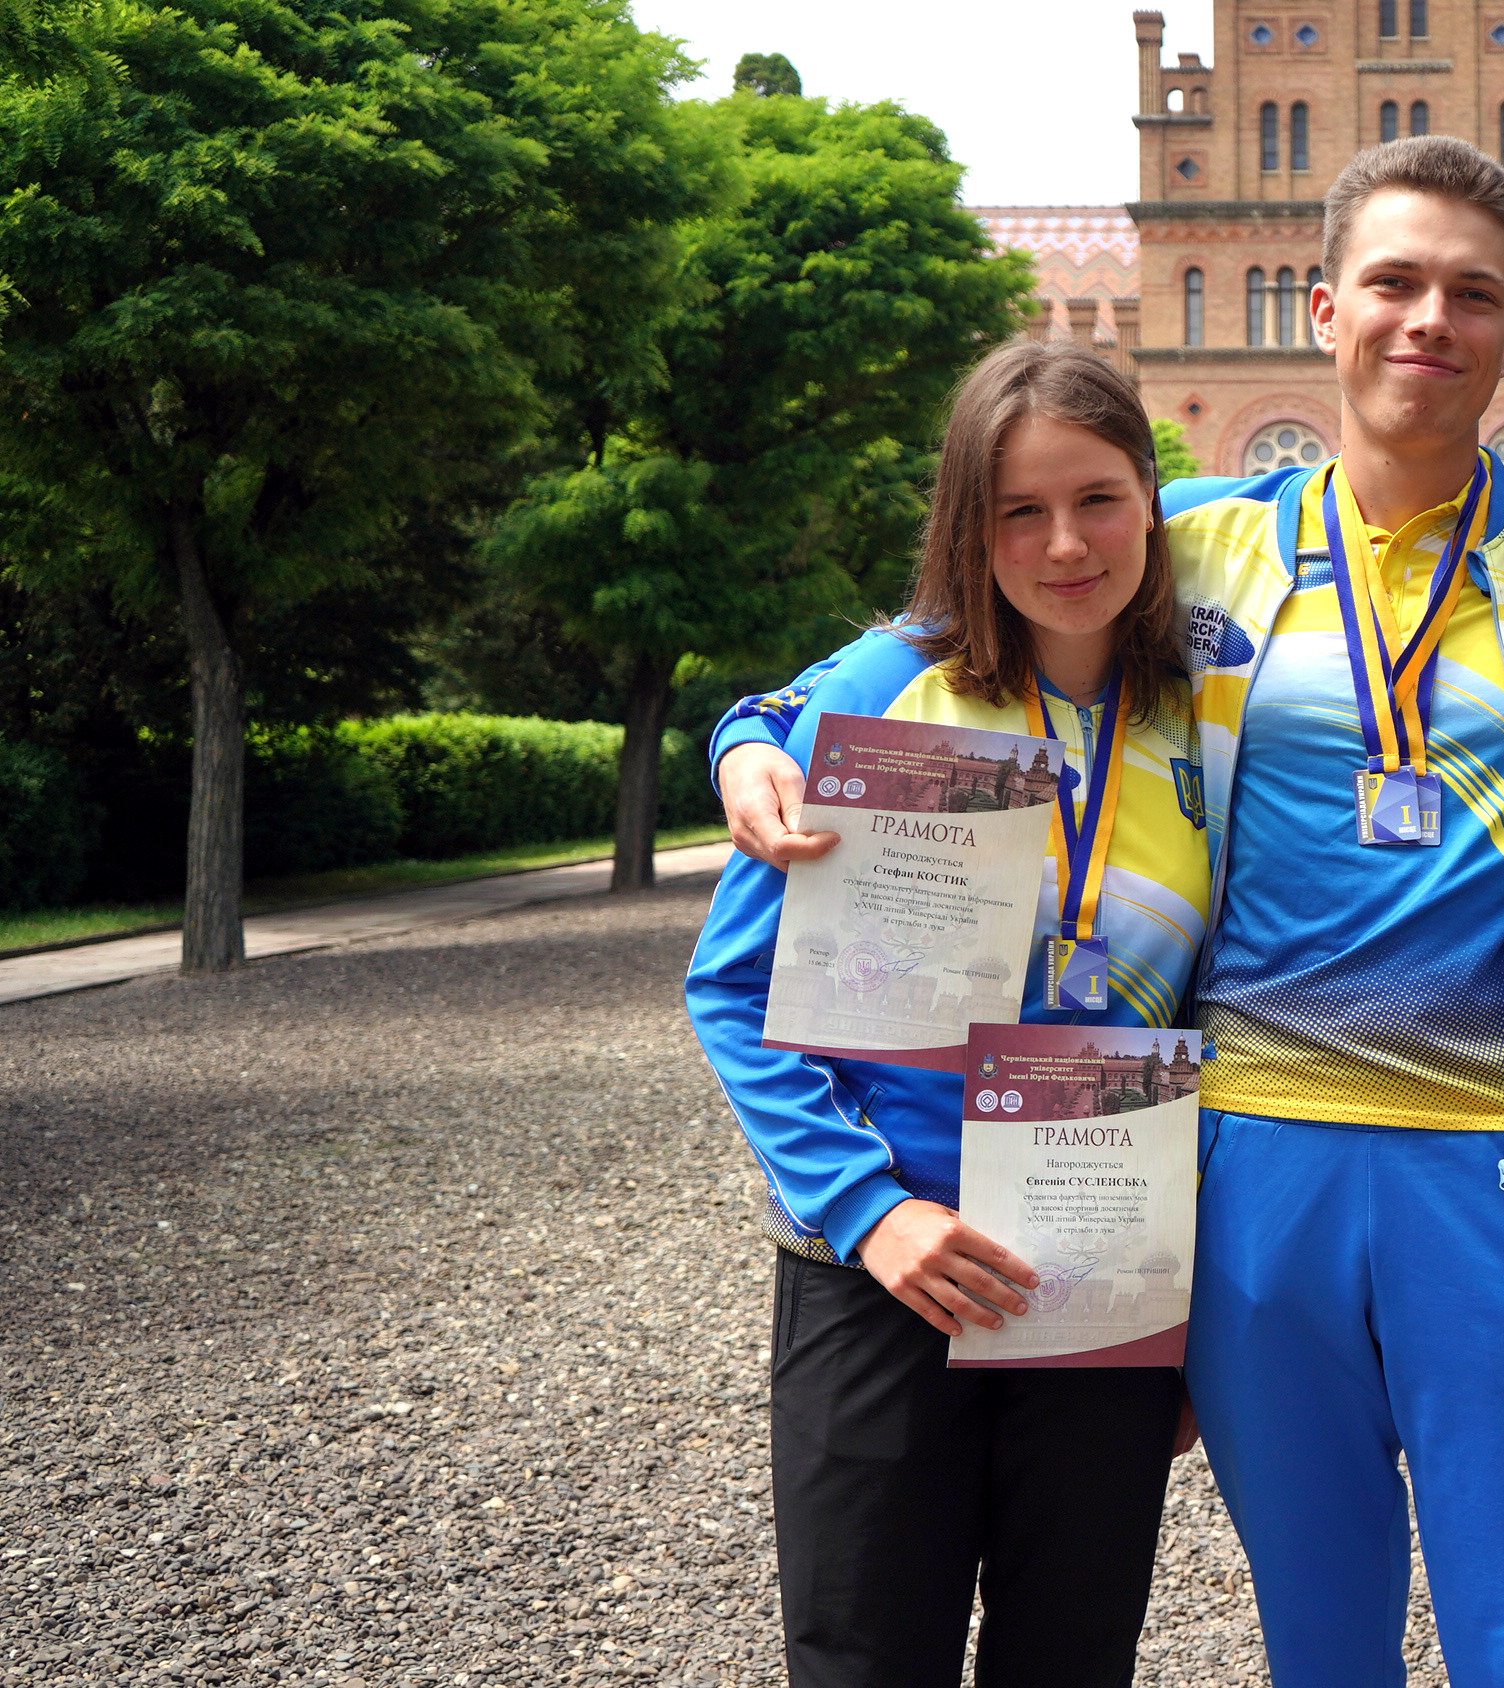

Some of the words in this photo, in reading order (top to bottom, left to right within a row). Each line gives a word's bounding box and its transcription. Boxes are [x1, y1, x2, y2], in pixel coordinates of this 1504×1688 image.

[849, 744, 903, 756] Чернівецький
[905, 751, 958, 762] національний
[878, 757, 924, 767] університет
[855, 762, 875, 770] імені
[877, 764, 896, 773] Юрія
[899, 767, 946, 778] Федьковича
[870, 814, 977, 848] ГРАМОТА
[882, 848, 964, 868] Нагороджується
[874, 864, 914, 878] Стефан
[917, 870, 968, 886] КОСТИК
[842, 878, 871, 886] студент
[873, 881, 913, 894] факультету
[914, 888, 956, 900] математики
[968, 894, 1014, 908] інформатики
[870, 893, 894, 902] високі
[896, 897, 930, 908] спортивні
[932, 902, 974, 913] досягнення
[861, 902, 882, 912] XVIII
[884, 905, 906, 915] літній
[908, 908, 948, 921] Універсіаді
[950, 914, 978, 926] України
[890, 918, 922, 928] стрільби
[929, 924, 945, 932] лука
[809, 948, 830, 958] Ректор
[942, 966, 961, 975] Роман
[1000, 1054, 1052, 1064] Чернівецький
[1030, 1065, 1074, 1073] університет
[1030, 1074, 1050, 1082] Юрія
[1034, 1127, 1134, 1148] ГРАМОТА
[1046, 1159, 1124, 1171] Нагороджується
[1026, 1176, 1066, 1186] Євгенія
[1068, 1177, 1148, 1188] СУСЛЕНСЬКА
[1023, 1194, 1057, 1202] студентка
[1078, 1216, 1116, 1224] Універсіаді
[1118, 1216, 1145, 1224] України
[1064, 1226, 1094, 1235] стрільби
